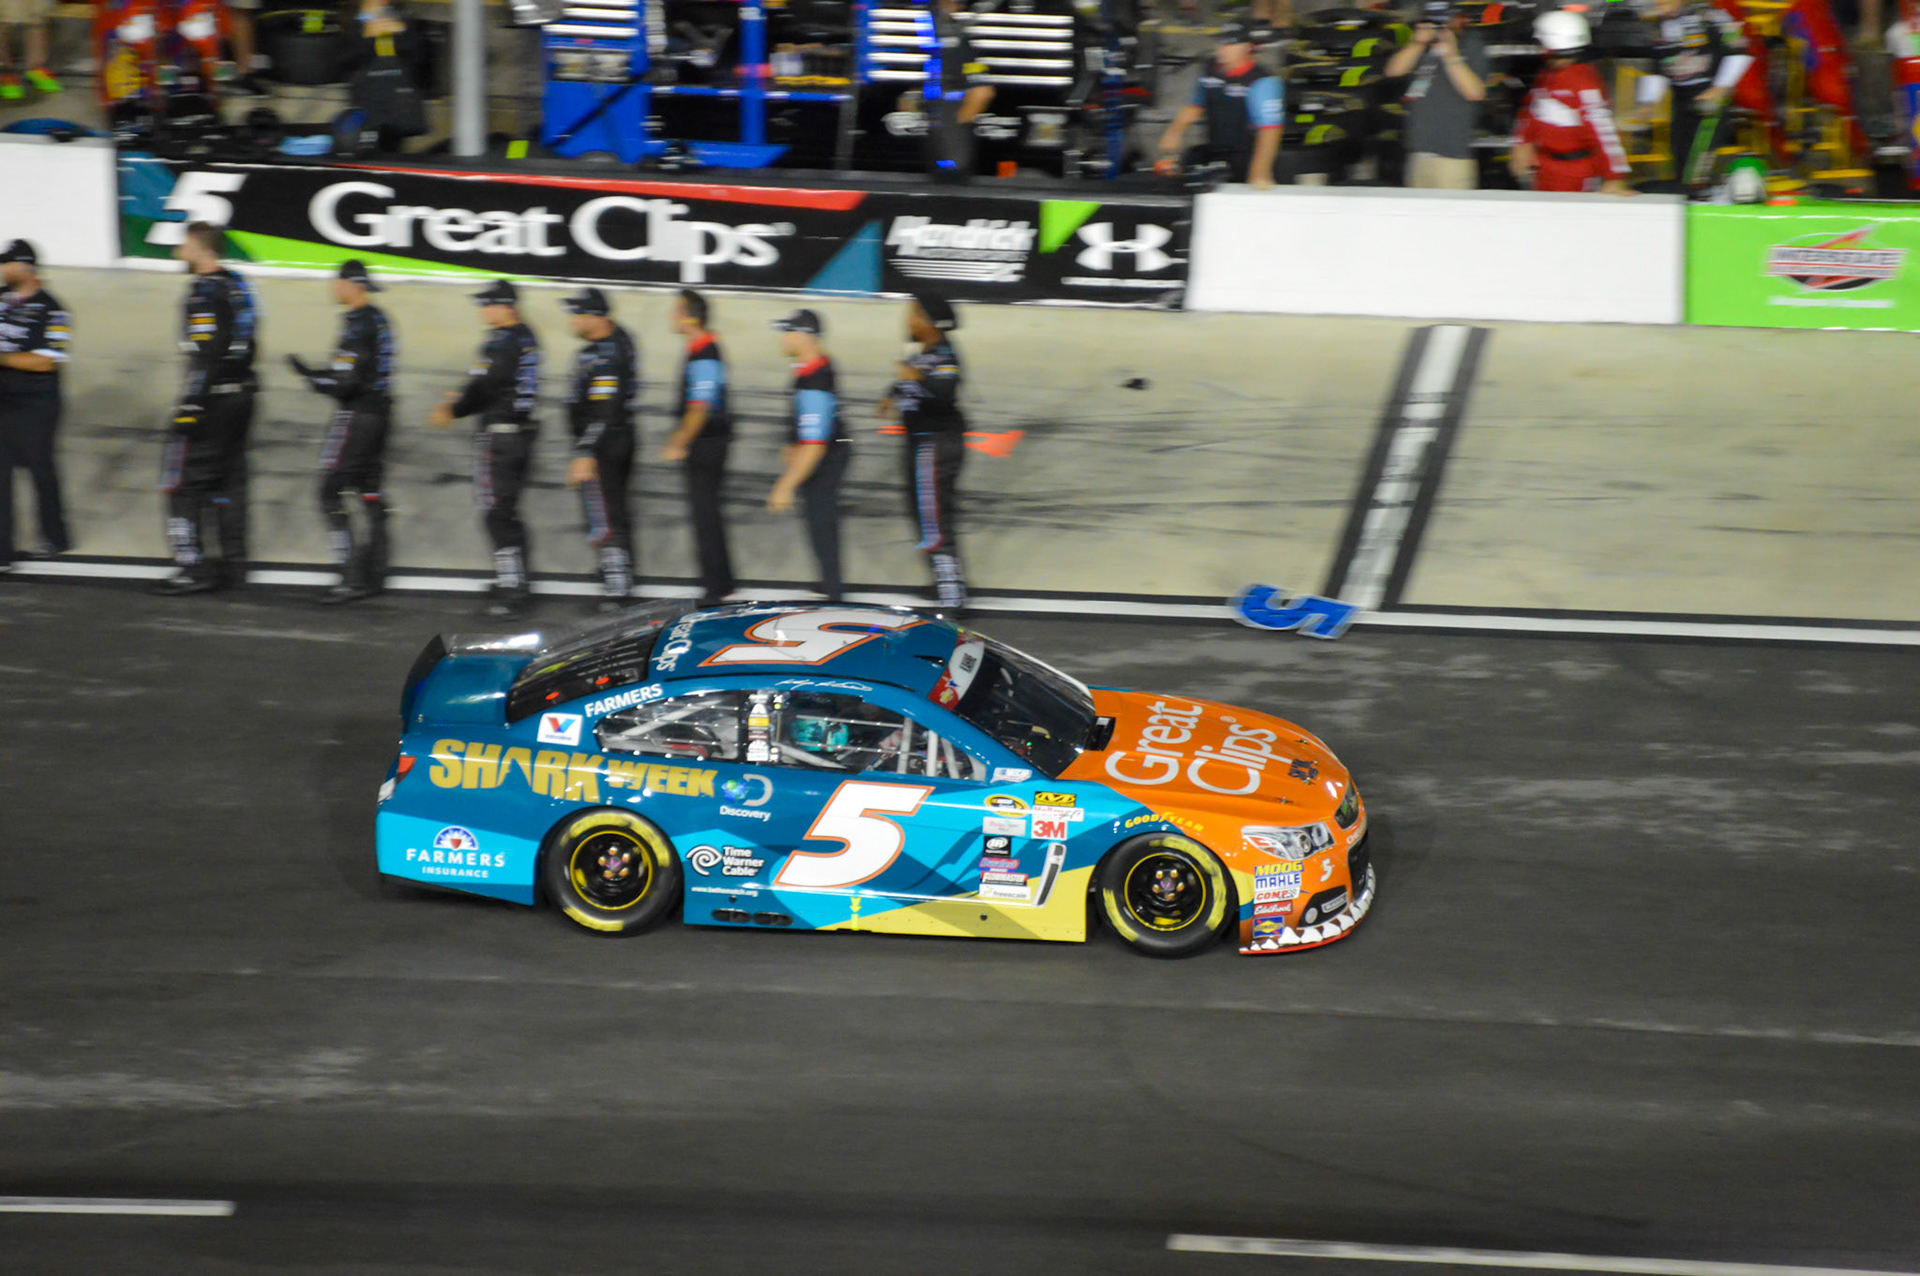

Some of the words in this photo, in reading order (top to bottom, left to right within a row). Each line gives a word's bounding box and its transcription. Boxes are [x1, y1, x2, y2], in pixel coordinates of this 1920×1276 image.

[145, 170, 248, 246] 5
[308, 181, 567, 256] Great
[571, 195, 782, 283] Clips
[1228, 582, 1357, 639] 5
[700, 609, 930, 666] 5
[584, 683, 664, 718] FARMERS
[1104, 701, 1204, 786] Great
[1186, 723, 1293, 796] Clips
[429, 739, 606, 804] SHARK
[607, 759, 719, 798] WEEK
[719, 805, 772, 822] Discovery
[1124, 811, 1205, 832] GOODYEAR
[772, 780, 937, 889] 5
[1033, 820, 1065, 839] 3M
[405, 848, 506, 868] FARMERS
[722, 845, 753, 858] Time
[722, 856, 766, 868] Warner
[421, 866, 490, 879] INSURANCE
[721, 866, 756, 876] Cable
[1255, 861, 1303, 876] MOOG
[1319, 858, 1333, 883] 5
[1255, 873, 1301, 890] MAHLE
